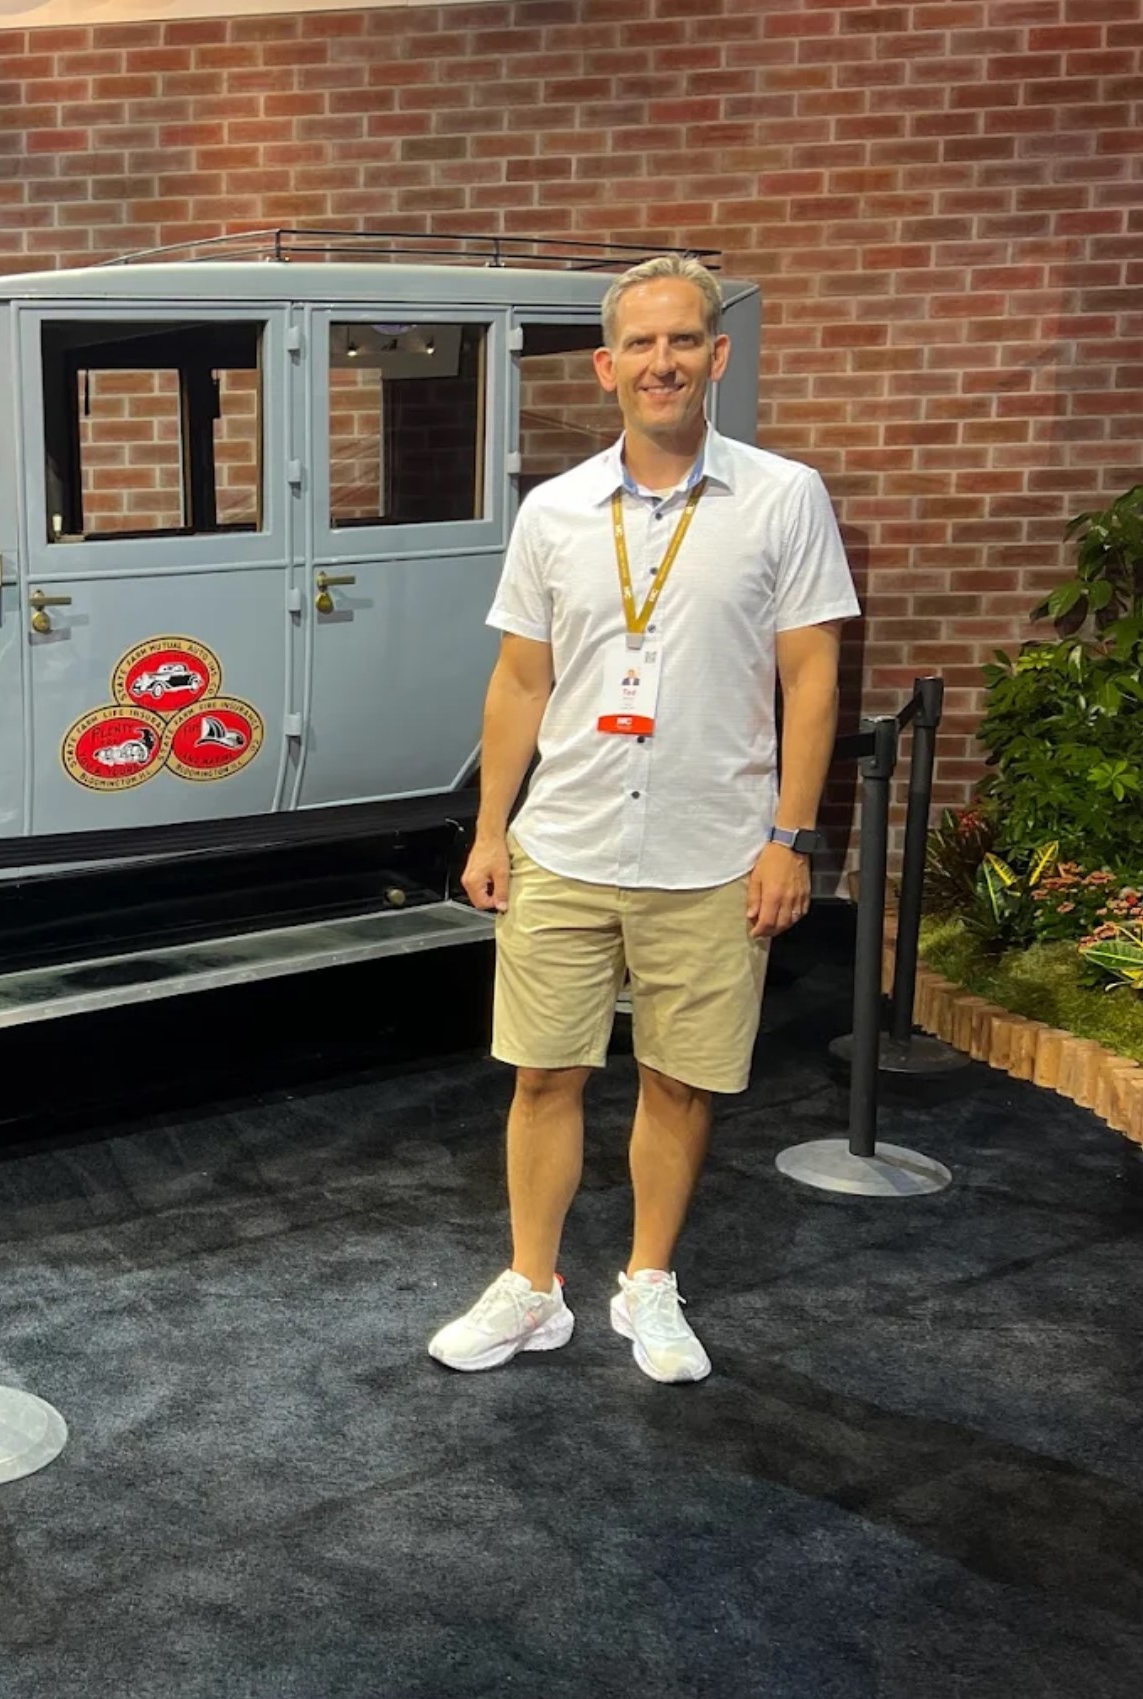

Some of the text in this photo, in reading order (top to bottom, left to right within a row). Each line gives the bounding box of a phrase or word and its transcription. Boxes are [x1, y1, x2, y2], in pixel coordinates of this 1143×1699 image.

[127, 648, 147, 667] FARM
[149, 641, 182, 651] MUTUAL
[187, 644, 209, 660] AUTO
[76, 716, 98, 733] FARM
[103, 710, 123, 718] LIFE
[174, 708, 194, 725] FARM
